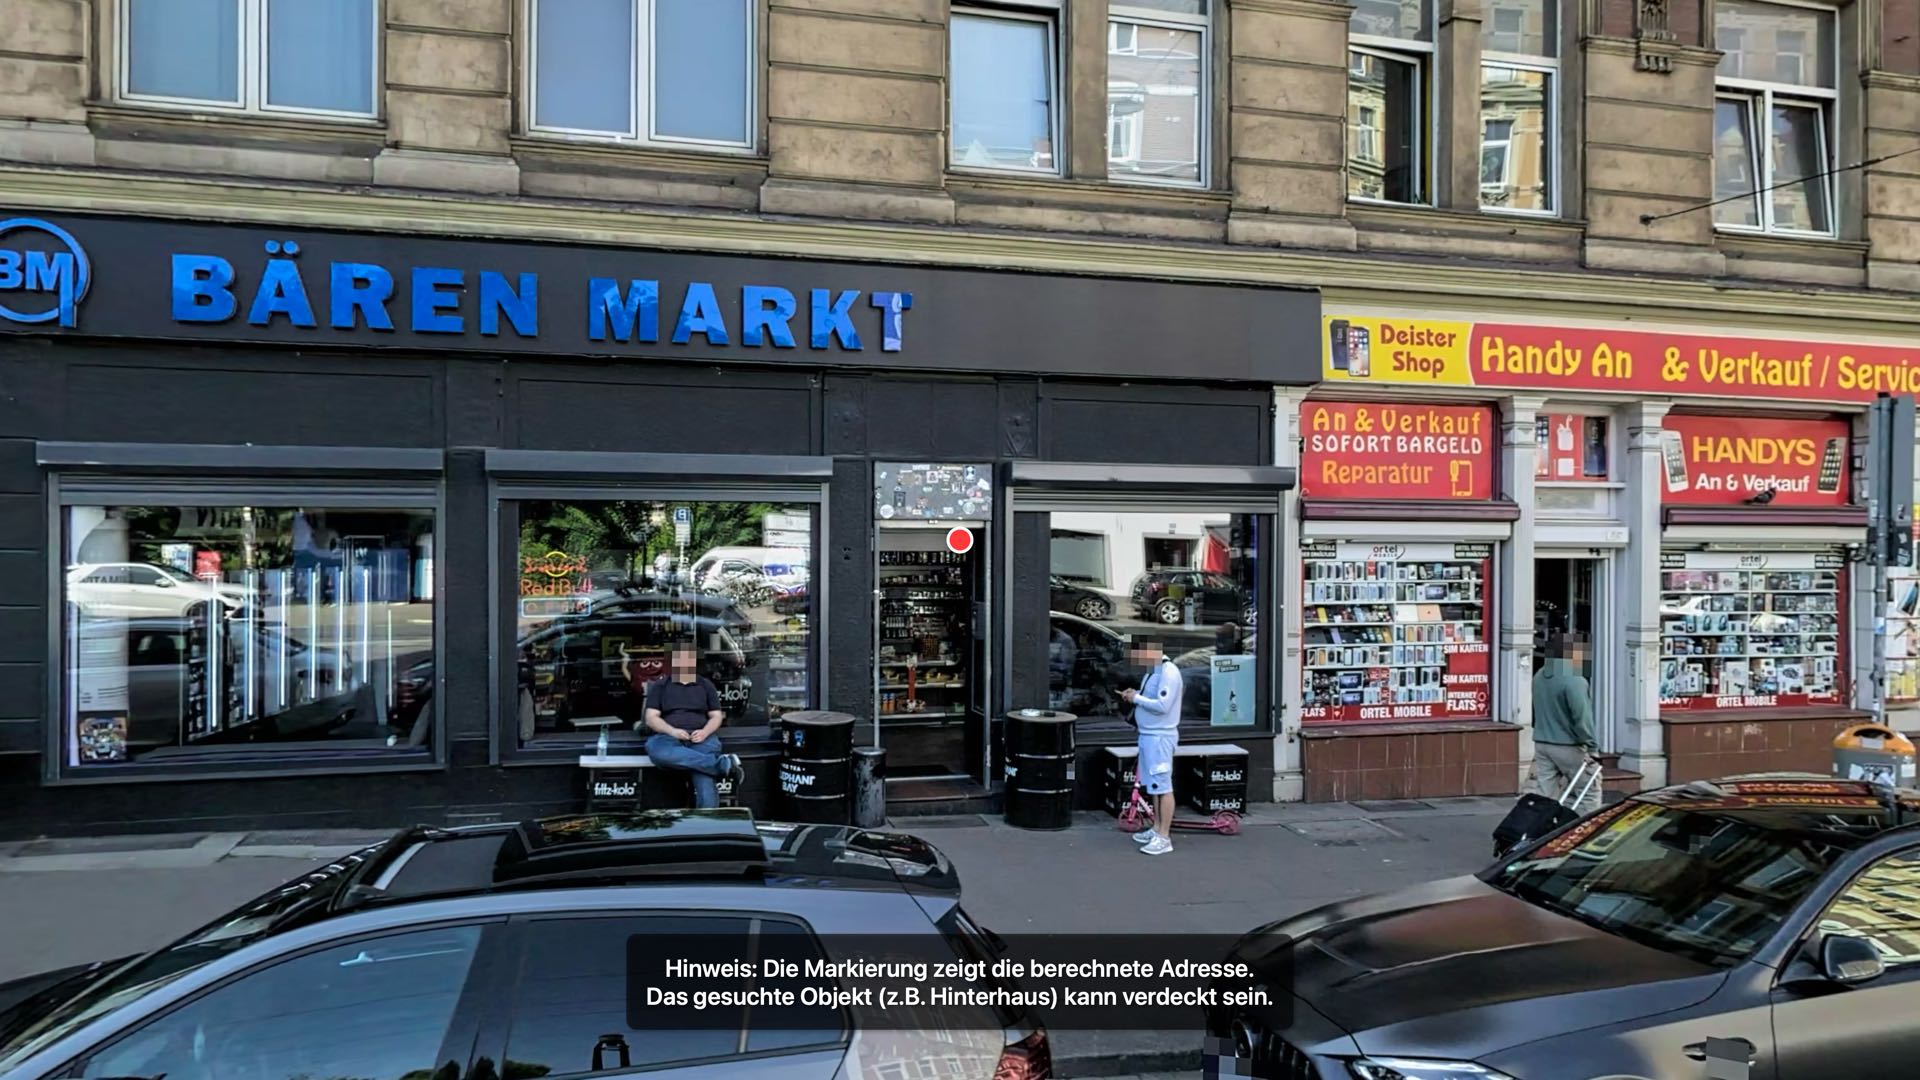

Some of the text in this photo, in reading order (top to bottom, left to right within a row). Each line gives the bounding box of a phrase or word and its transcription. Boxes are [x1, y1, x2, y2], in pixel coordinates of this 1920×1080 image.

[0, 250, 76, 328] BM
[171, 240, 913, 352] BÄREN MARKT
[1380, 324, 1457, 348] Deister
[1392, 352, 1445, 378] Shop
[1481, 336, 1582, 377] Handy
[1592, 342, 1633, 379] An
[1662, 346, 1690, 383] &
[1698, 348, 1813, 387] Verkauf
[1819, 355, 1831, 388] /
[1312, 407, 1481, 434] An & Verkauf
[1311, 434, 1482, 454] SOFORT BARGELD
[1692, 436, 1817, 466] HANDYS
[1322, 459, 1434, 485] Reparatur
[1695, 473, 1810, 492] An & Verkauf
[1372, 544, 1398, 553] ortel
[520, 577, 555, 596] Red
[1443, 643, 1489, 654] SIM KARTEN
[1442, 674, 1488, 684] SIM KARTEN
[1446, 700, 1477, 711] FLATS
[1716, 695, 1777, 708] ORTEL MOBILE
[1360, 705, 1432, 719] ORTEL MOBILE
